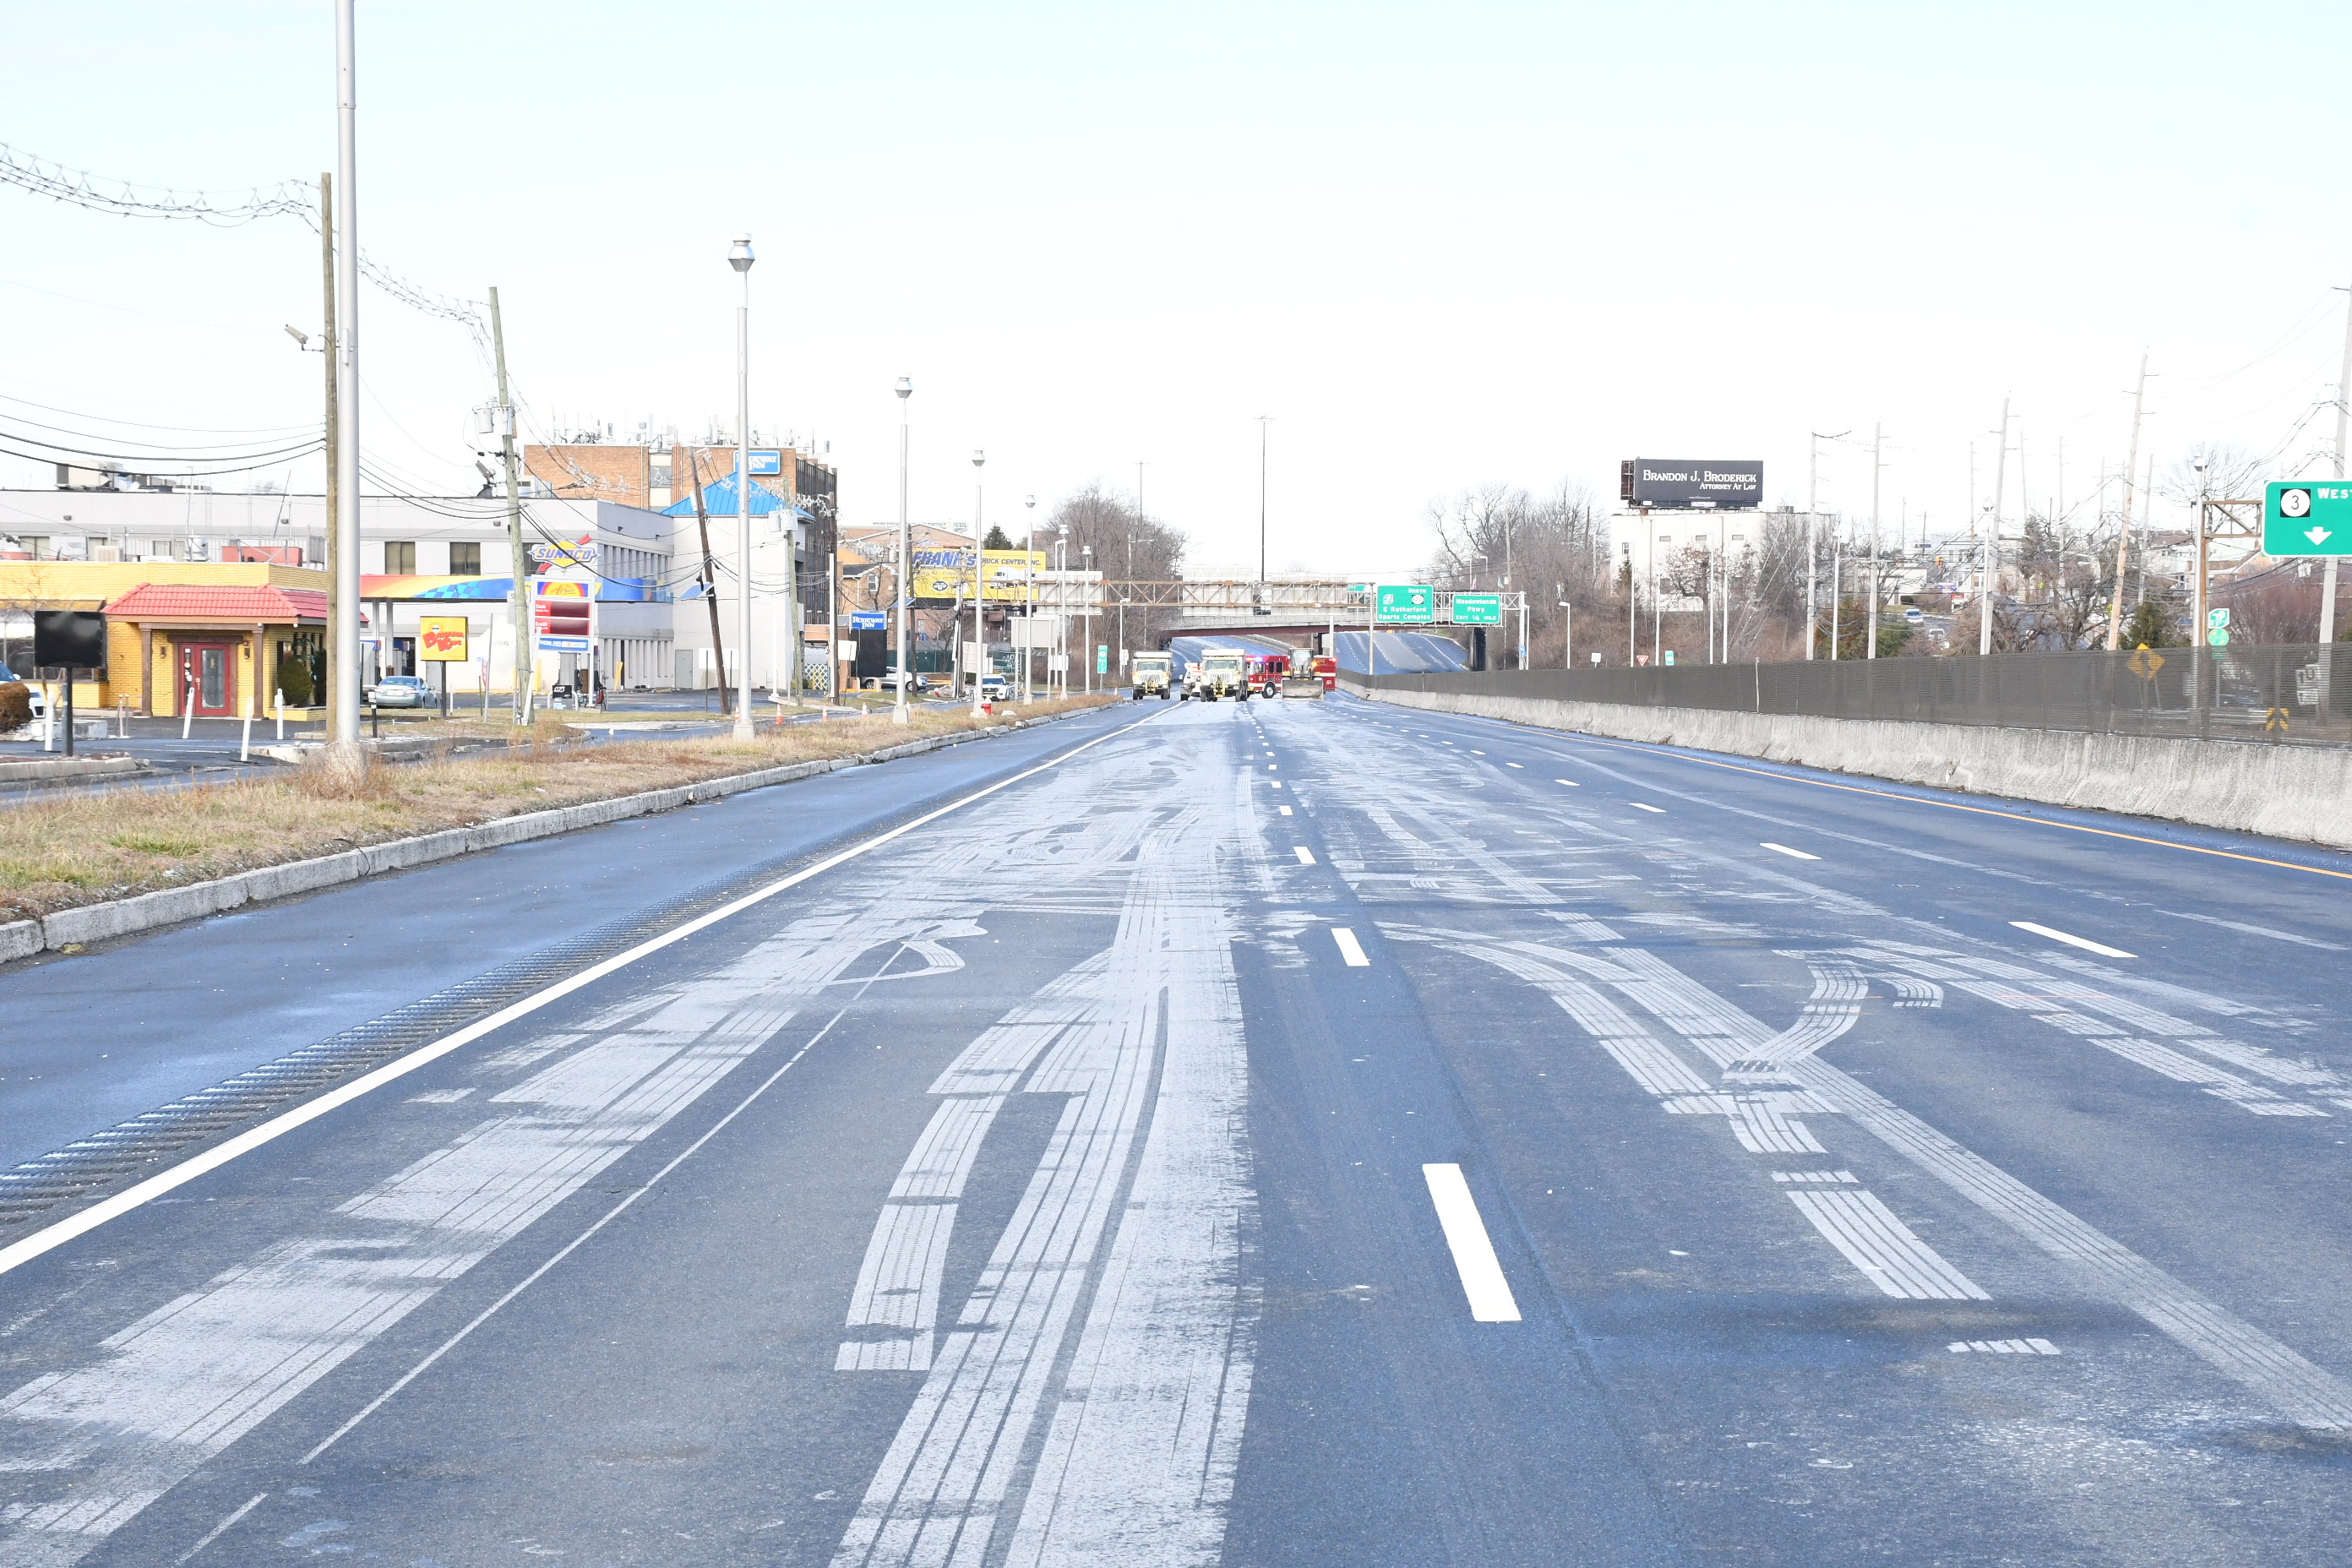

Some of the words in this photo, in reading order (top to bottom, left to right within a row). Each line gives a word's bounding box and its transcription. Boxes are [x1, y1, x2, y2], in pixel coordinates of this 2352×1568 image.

[1642, 470, 1688, 482] BRANDON
[1690, 471, 1701, 482] J.
[1703, 471, 1757, 482] BRODERICK
[2290, 494, 2300, 510] 3
[536, 547, 592, 560] SUNOCO
